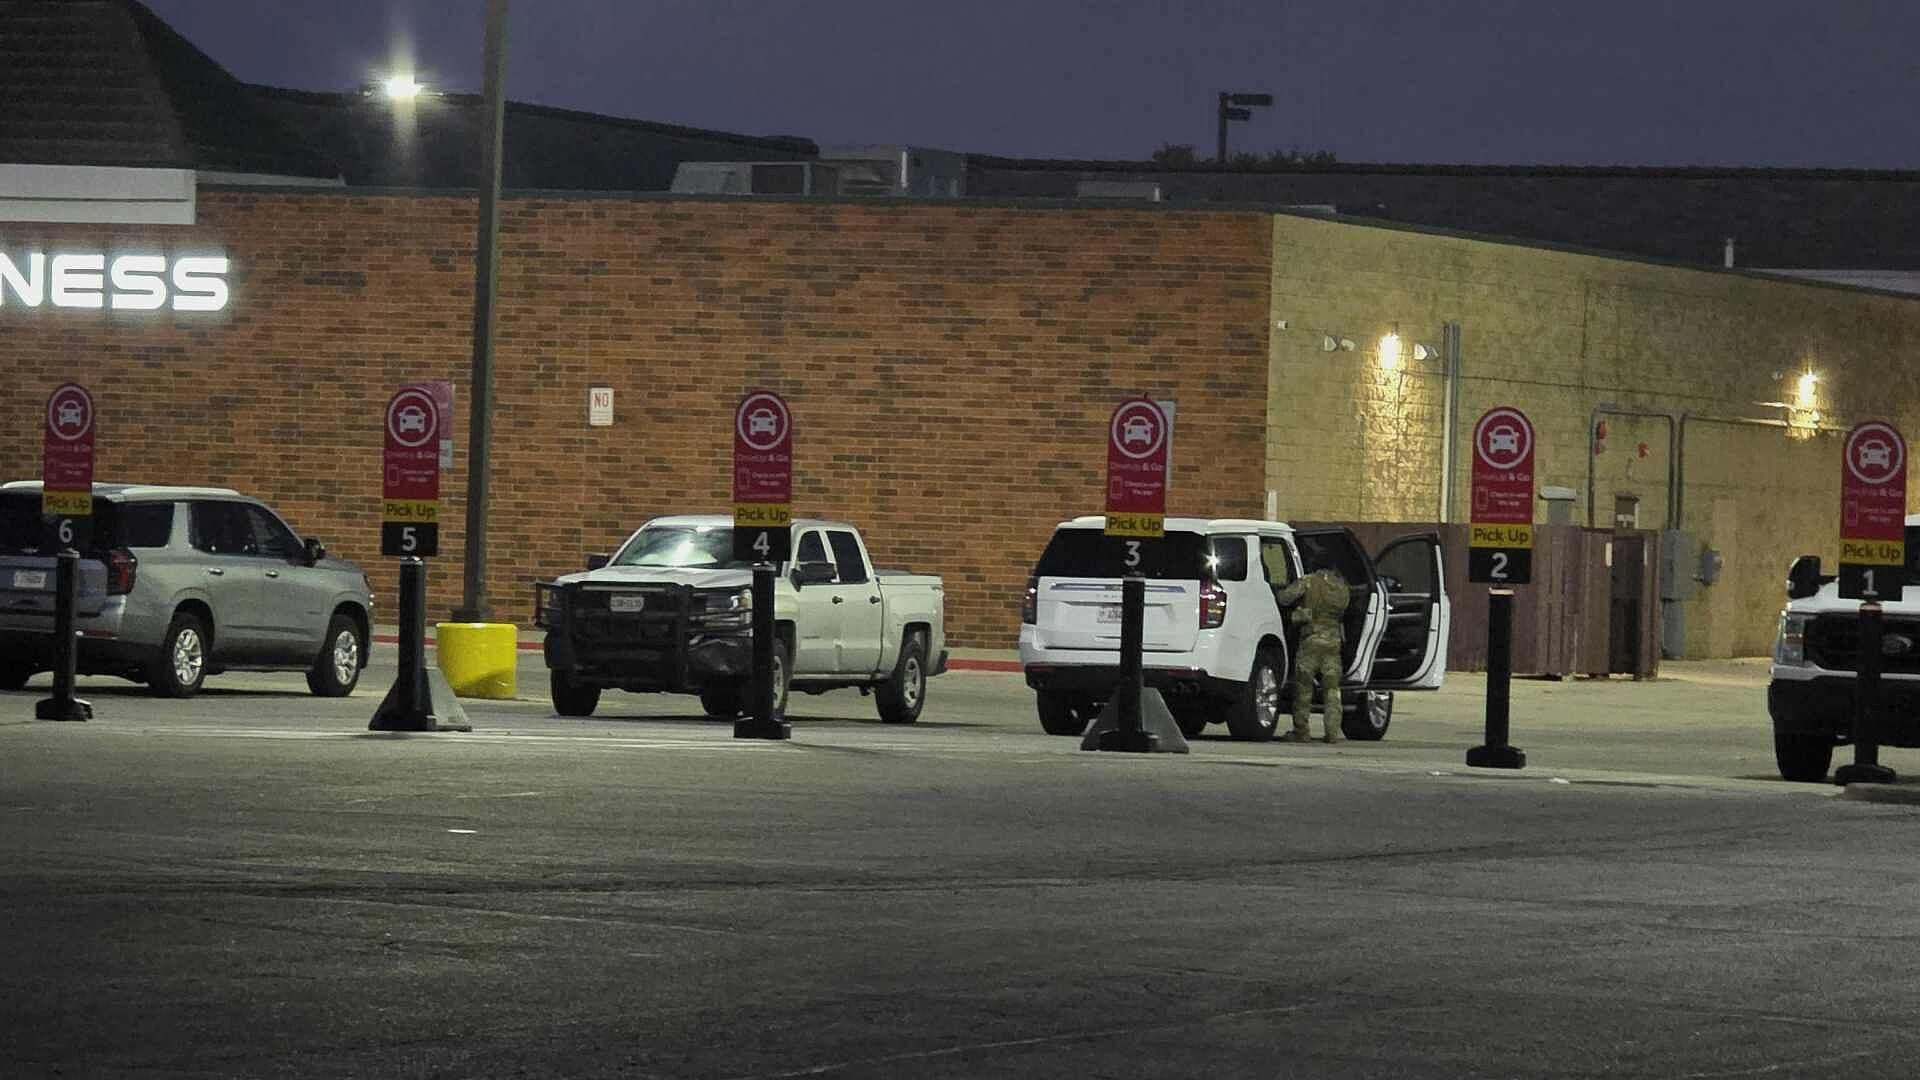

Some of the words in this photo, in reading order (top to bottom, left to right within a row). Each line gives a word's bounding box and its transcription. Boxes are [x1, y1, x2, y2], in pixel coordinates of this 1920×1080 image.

[0, 252, 230, 311] NESS
[594, 392, 609, 408] NO
[386, 504, 412, 516] Pick
[416, 504, 436, 520] Up
[737, 508, 764, 520] Pick
[769, 508, 788, 522] Up
[60, 519, 73, 543] 6
[1109, 517, 1136, 529] Pick
[1141, 518, 1161, 532] Up
[1474, 528, 1504, 541] Pick
[1508, 528, 1529, 544] Up
[402, 527, 417, 551] 5
[753, 531, 770, 556] 4
[1124, 541, 1141, 566] 3
[1844, 543, 1873, 557] Pick
[1879, 543, 1900, 562] Up
[1490, 552, 1508, 578] 2
[1863, 570, 1879, 595] 1
